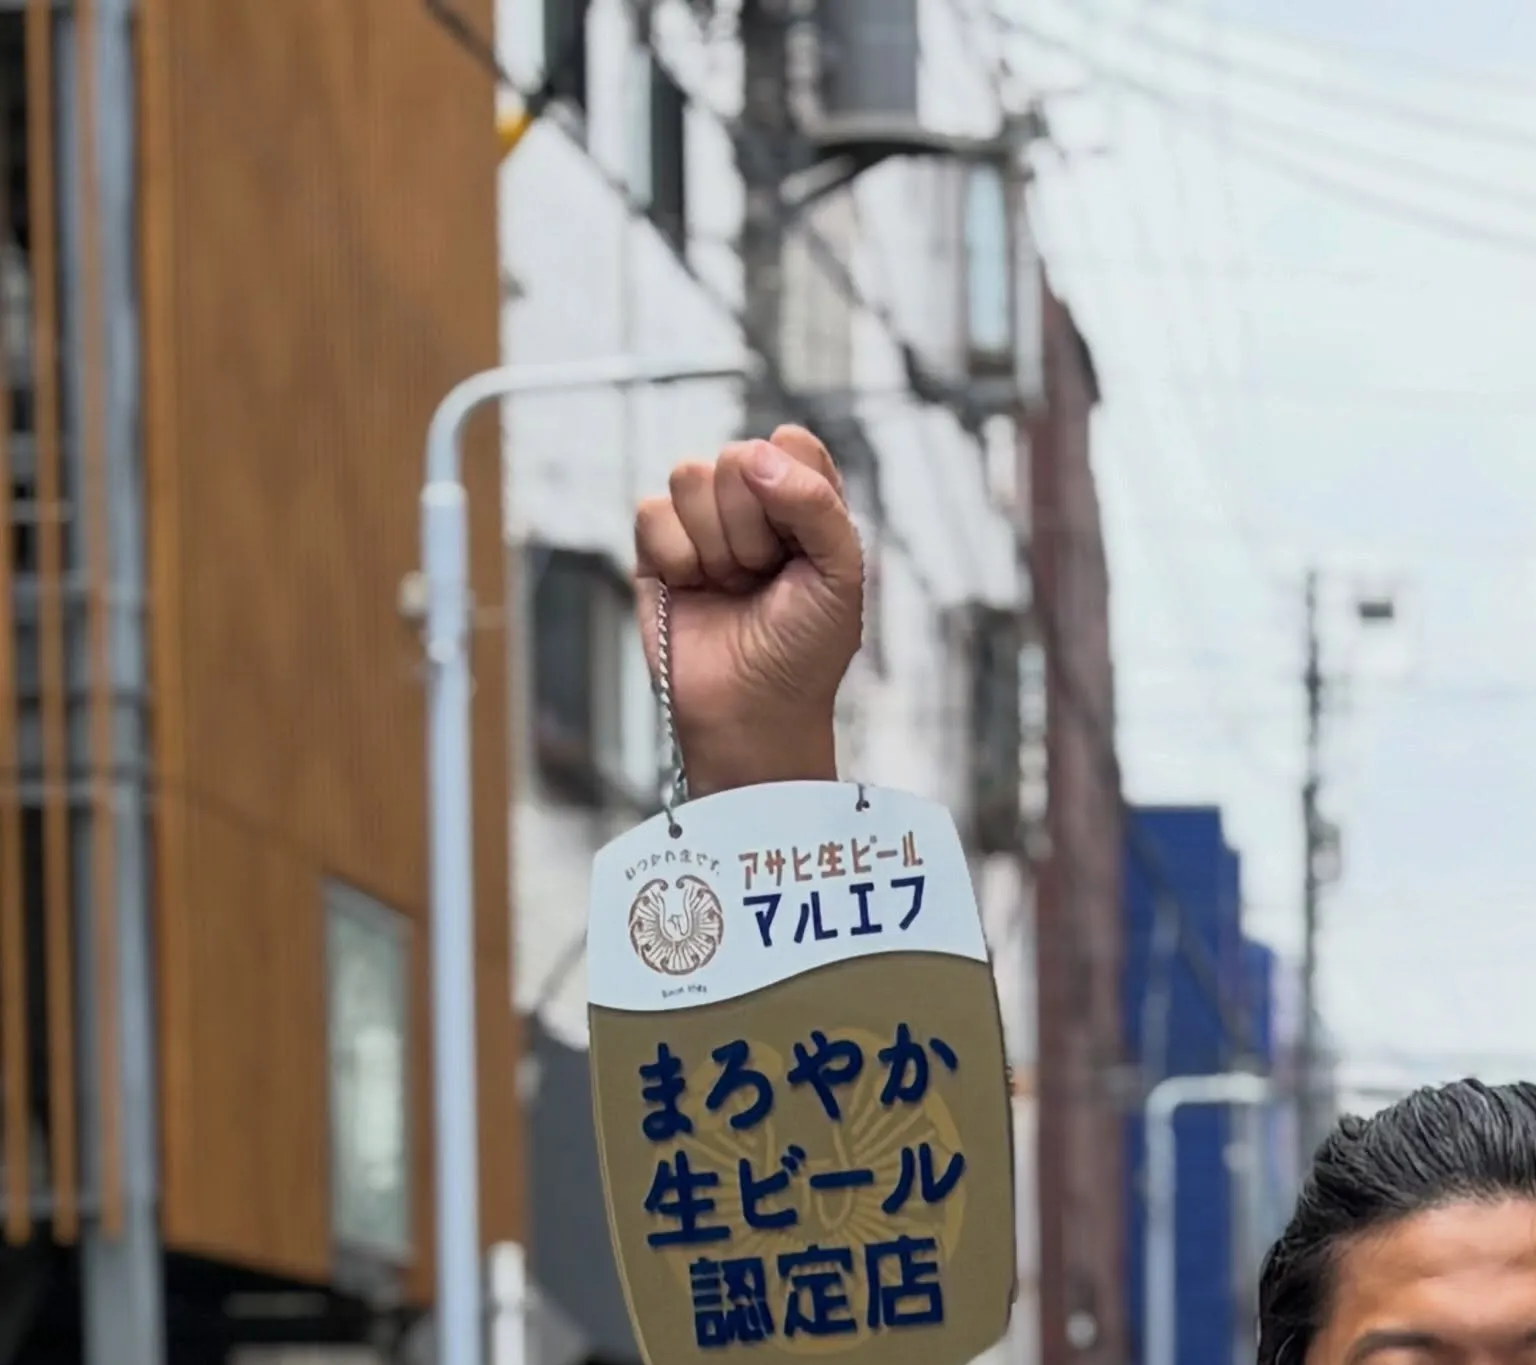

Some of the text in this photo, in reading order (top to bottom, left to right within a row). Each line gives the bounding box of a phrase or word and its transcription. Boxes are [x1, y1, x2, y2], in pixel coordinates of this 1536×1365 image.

[738, 830, 924, 890] アサヒ生ビール
[743, 875, 925, 947] マルエフ
[639, 1022, 959, 1142] まろやか
[644, 1142, 966, 1248] 生ビール
[689, 1235, 945, 1348] 認定店
